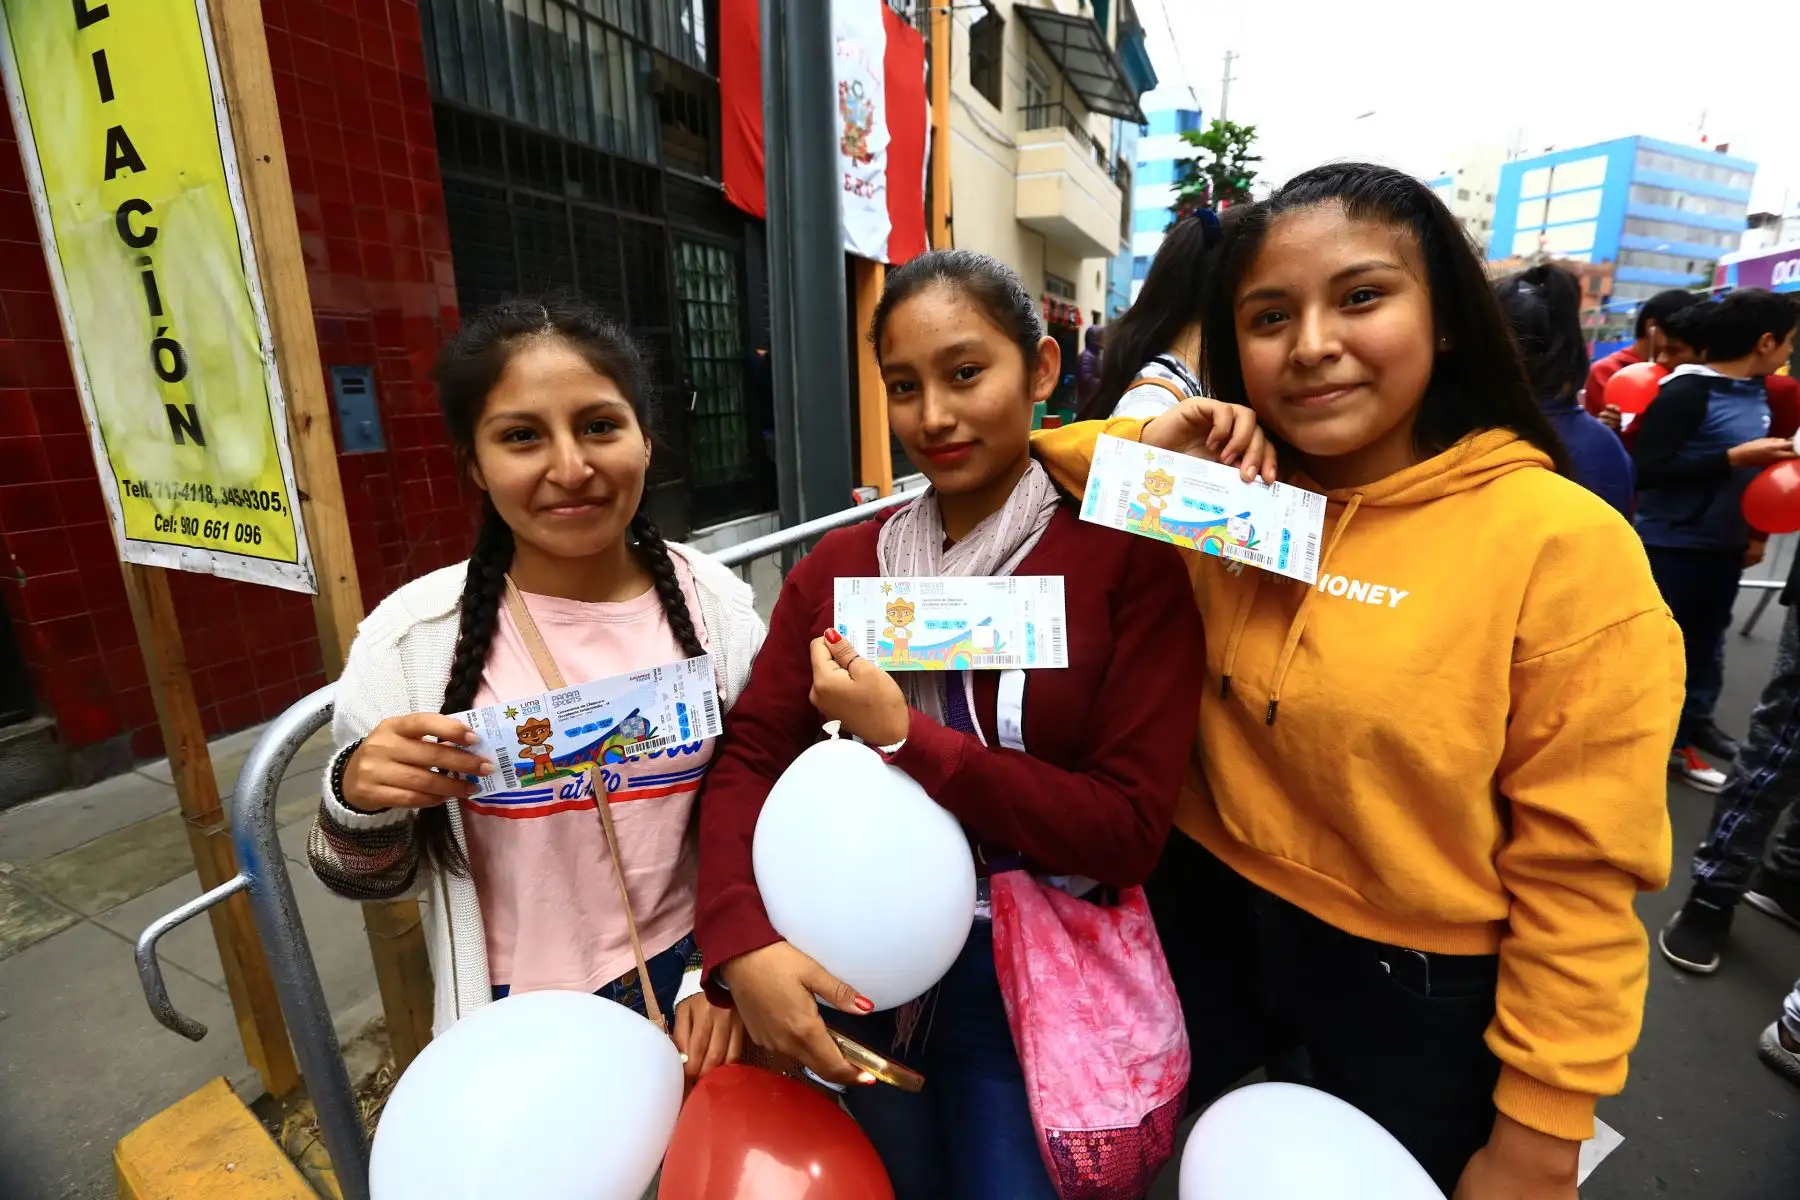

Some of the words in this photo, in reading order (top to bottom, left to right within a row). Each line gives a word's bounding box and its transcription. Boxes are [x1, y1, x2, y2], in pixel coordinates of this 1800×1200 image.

[220, 486, 288, 517] 345-9305,
[154, 513, 177, 534] Cel:
[203, 519, 230, 541] 661
[235, 523, 262, 545] 096
[522, 704, 542, 715] 2019
[551, 696, 582, 709] SPORTS
